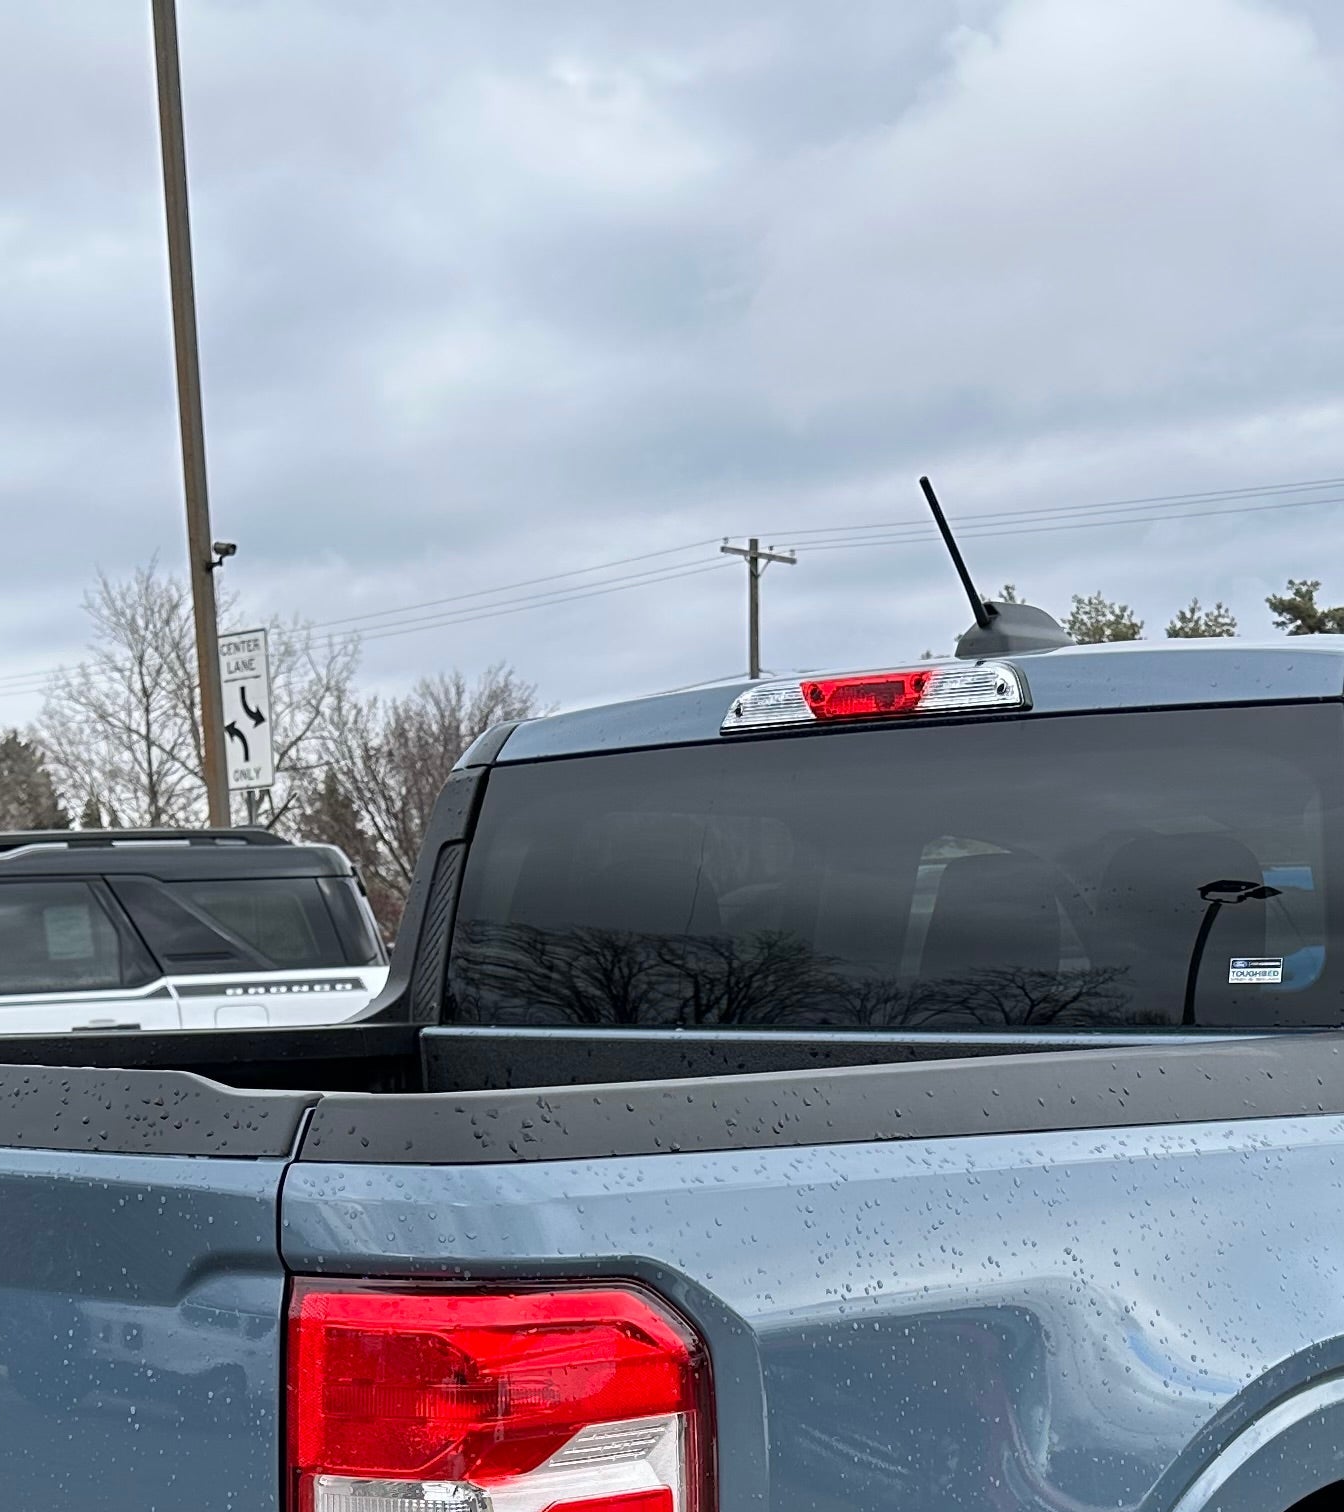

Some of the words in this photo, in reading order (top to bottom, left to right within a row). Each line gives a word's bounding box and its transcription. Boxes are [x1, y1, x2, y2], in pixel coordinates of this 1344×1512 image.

[219, 638, 260, 656] CENTER
[226, 658, 256, 675] LANE
[233, 767, 262, 782] ONLY
